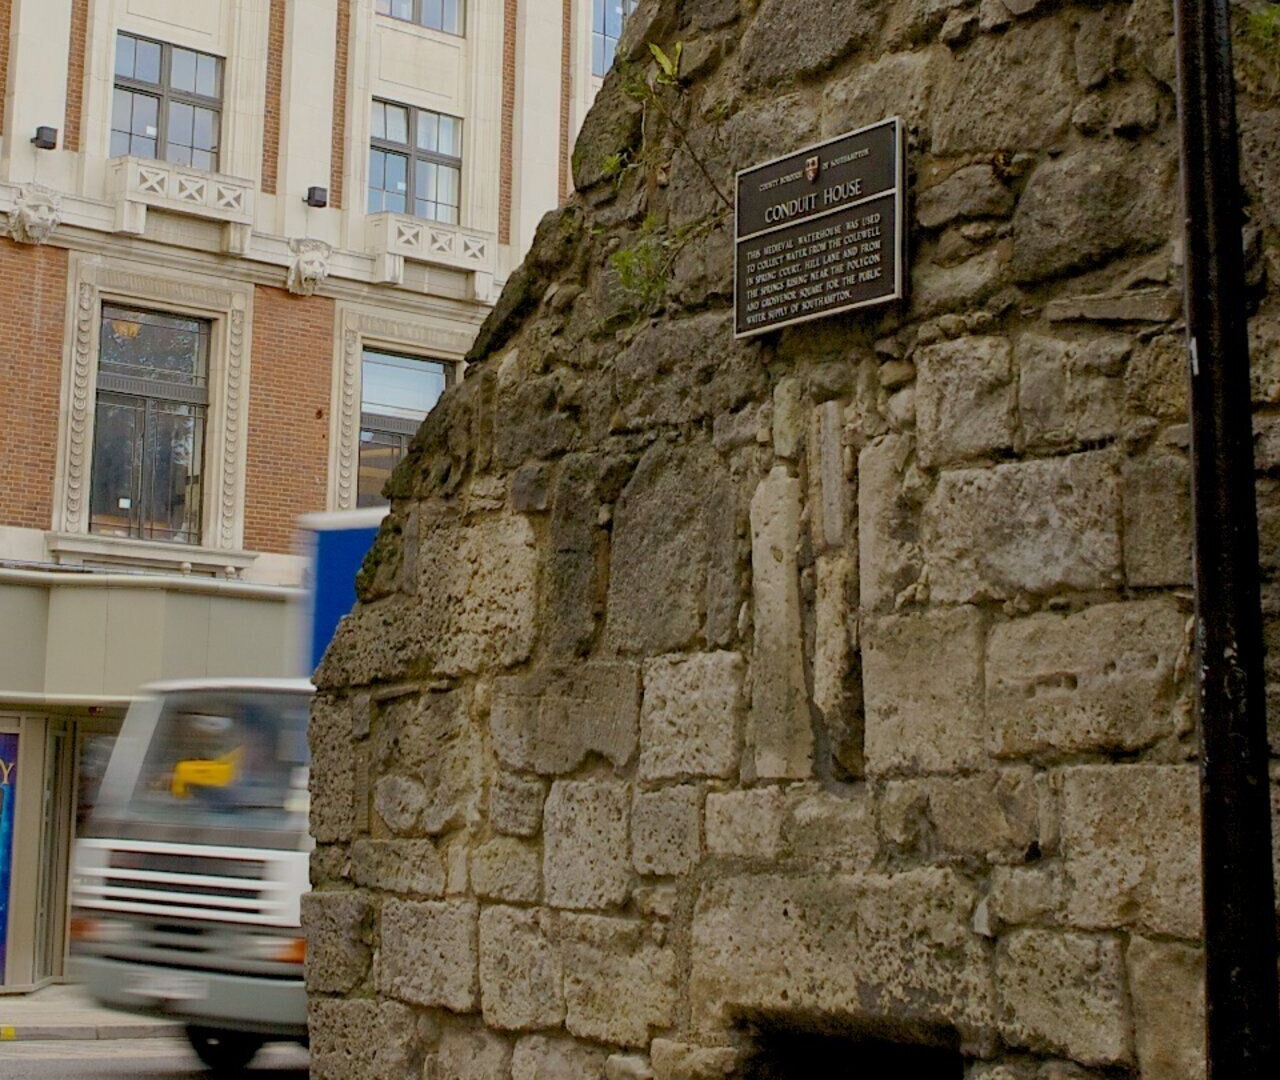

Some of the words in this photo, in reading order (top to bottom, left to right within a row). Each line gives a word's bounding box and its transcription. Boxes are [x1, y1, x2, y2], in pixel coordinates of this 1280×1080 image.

[764, 192, 818, 223] CONDUIT
[824, 178, 863, 205] HOUSE
[747, 250, 760, 260] THIS
[764, 240, 793, 255] MEDIEVAL
[798, 225, 842, 244] WATERHOUSE
[846, 220, 859, 230] WAS
[862, 213, 880, 226] USED
[747, 263, 755, 273] TO
[786, 248, 808, 261] WATER
[808, 241, 827, 254] FROM
[828, 238, 842, 250] THE
[843, 226, 881, 244] COLEWELL
[805, 258, 821, 269] HILL
[823, 252, 841, 264] LANE
[843, 246, 858, 258] AND
[860, 240, 881, 253] FROM
[747, 289, 758, 299] THE
[810, 268, 829, 280] NEAR
[831, 264, 844, 275] THE
[747, 301, 759, 312] AND
[826, 279, 840, 290] FOR
[842, 275, 856, 286] THE
[858, 267, 882, 281] PUBLIC
[790, 304, 800, 313] OF
